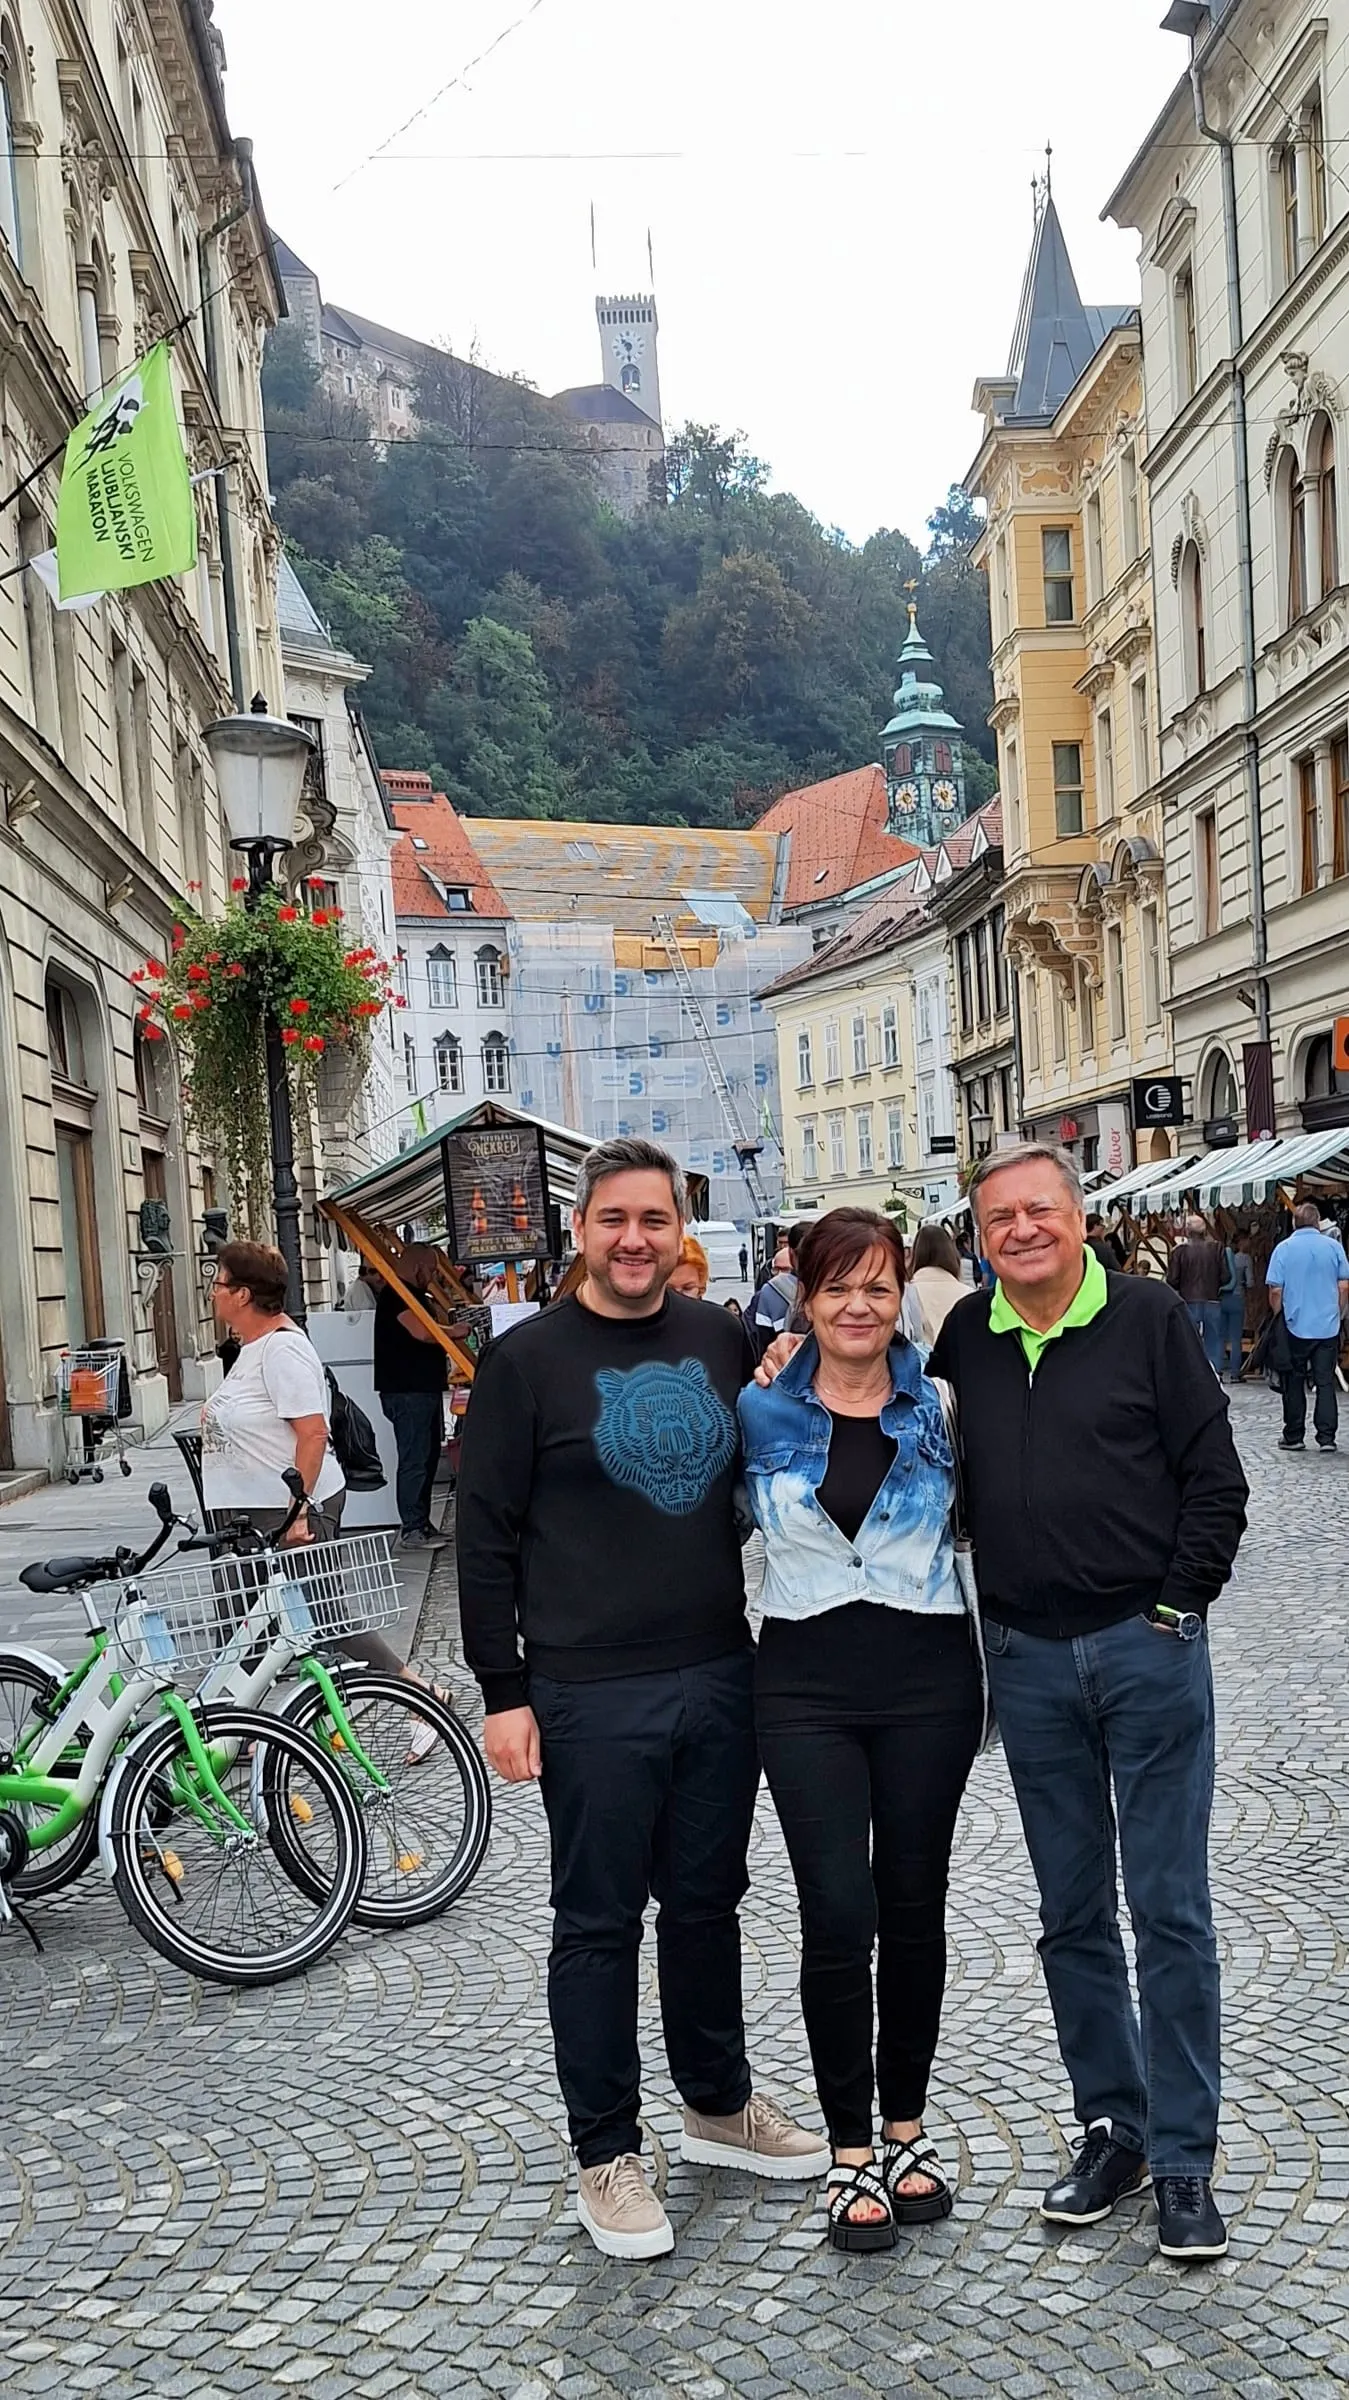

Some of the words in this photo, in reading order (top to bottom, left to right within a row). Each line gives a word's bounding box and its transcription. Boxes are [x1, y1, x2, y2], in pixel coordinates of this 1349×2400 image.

[86, 467, 111, 542] MARATON
[101, 459, 136, 560] LJUBLJANSKI
[118, 452, 156, 562] VOLKSWAGEN
[831, 2196, 849, 2223] LOVE
[856, 2172, 881, 2194] LOVE
